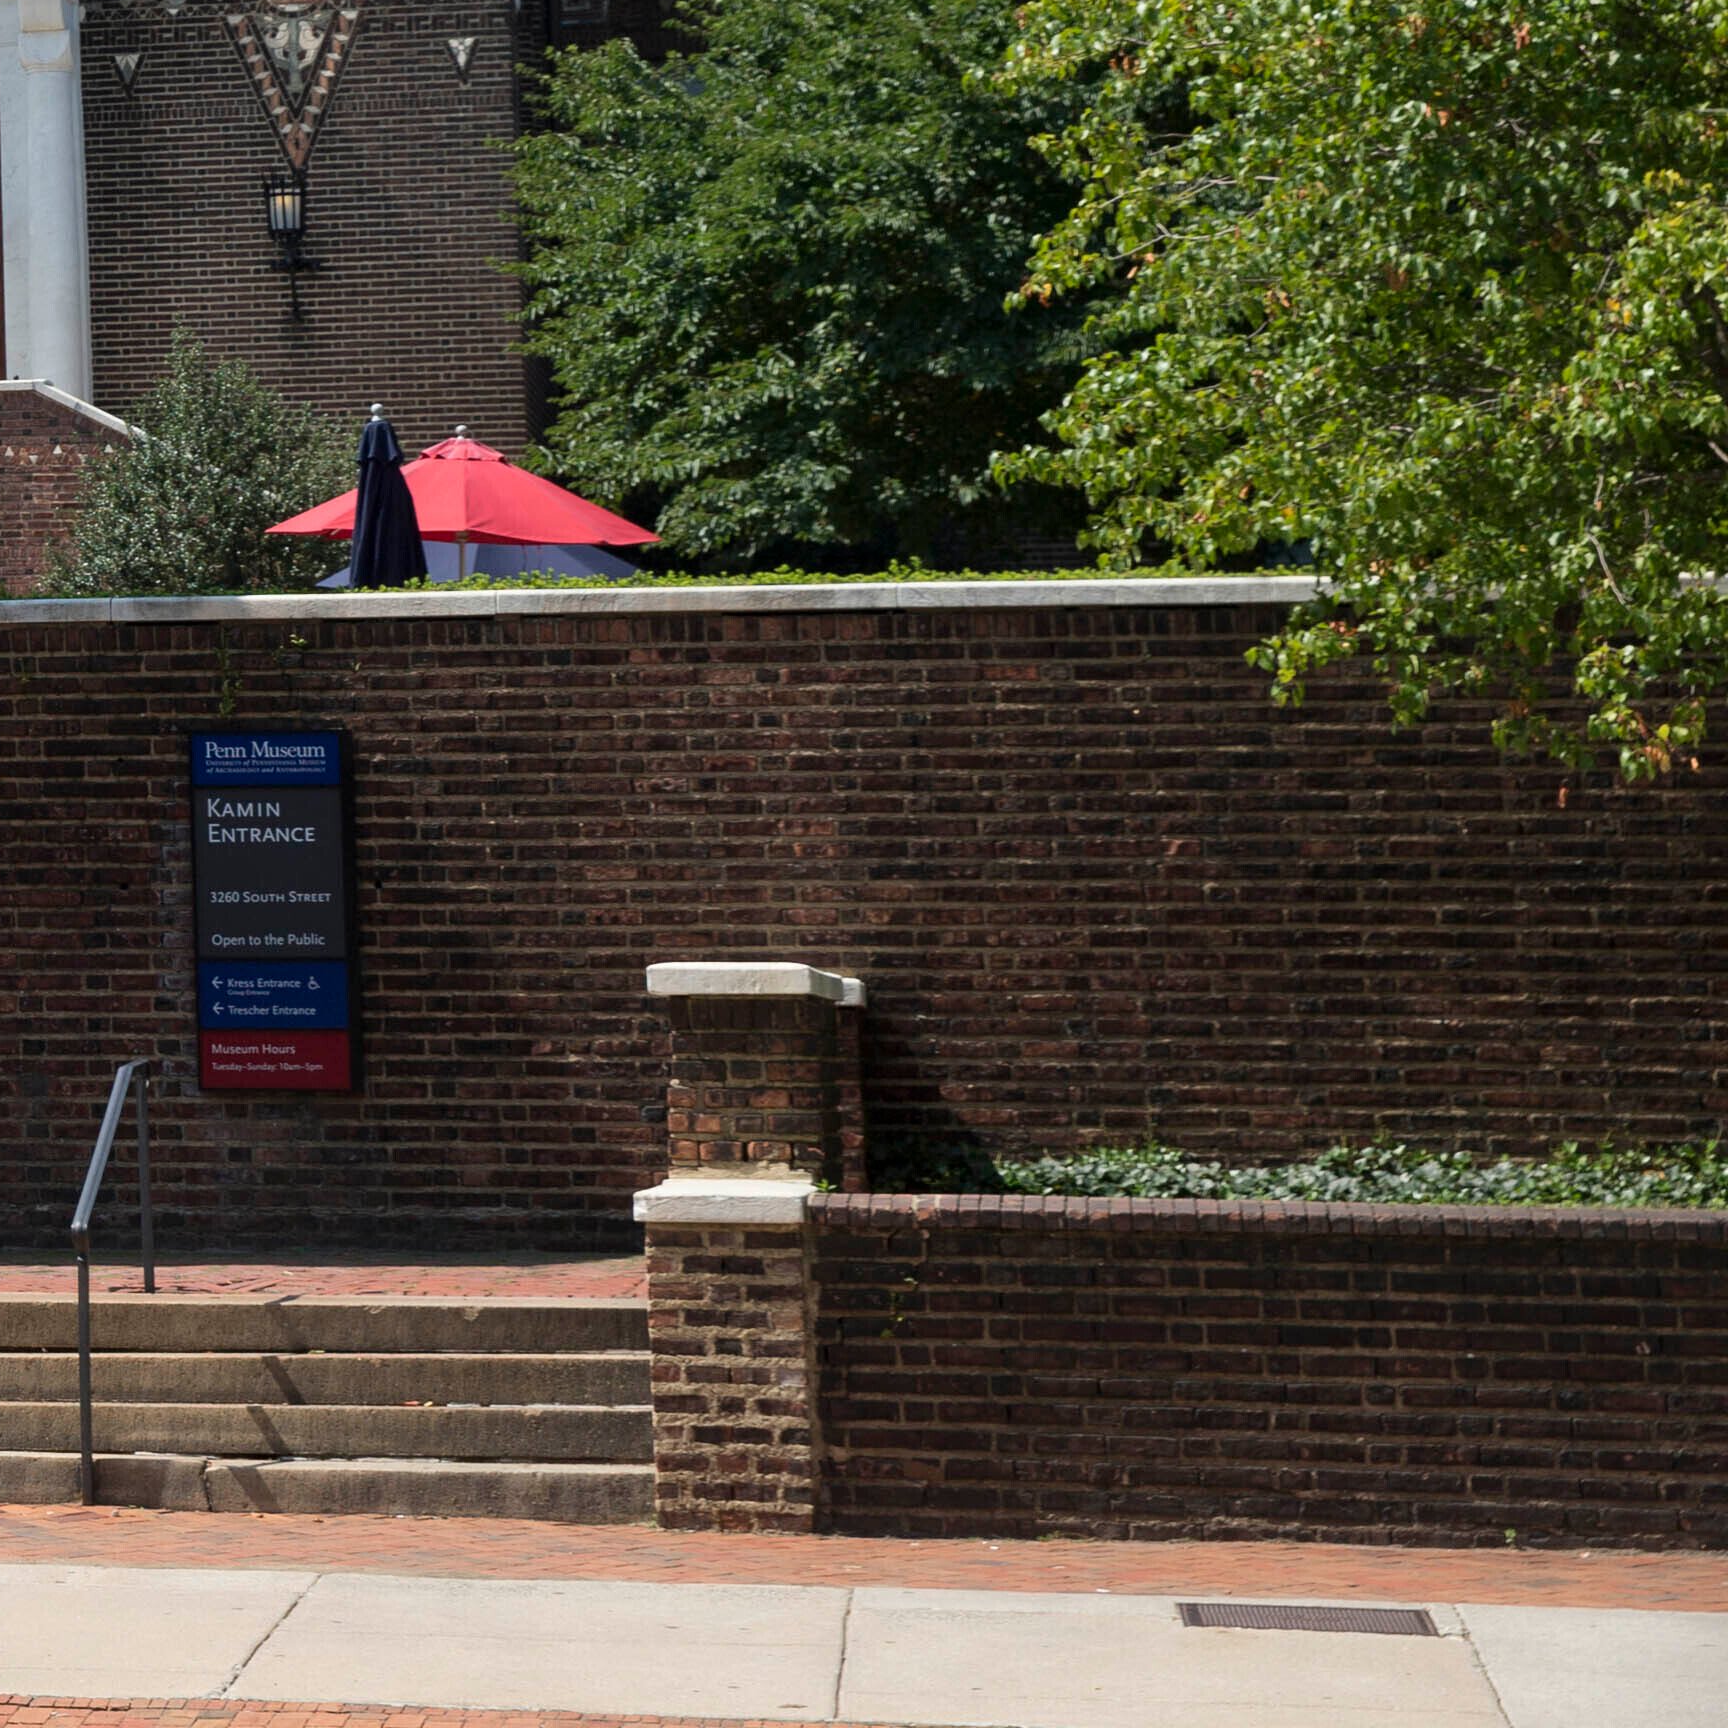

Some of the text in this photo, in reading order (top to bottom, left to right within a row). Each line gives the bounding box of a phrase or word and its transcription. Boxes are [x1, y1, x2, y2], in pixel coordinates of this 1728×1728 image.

[205, 741, 325, 758] Penn Museum
[207, 798, 280, 817] KAMIN
[208, 823, 316, 843] ENTRANCE
[210, 890, 332, 903] 3260 SOUTH STREET
[211, 932, 326, 948] Open to the Public
[227, 978, 302, 988] Kress Entrance
[228, 1004, 317, 1015] Trescher Entrance
[211, 1043, 296, 1055] Museum Hours
